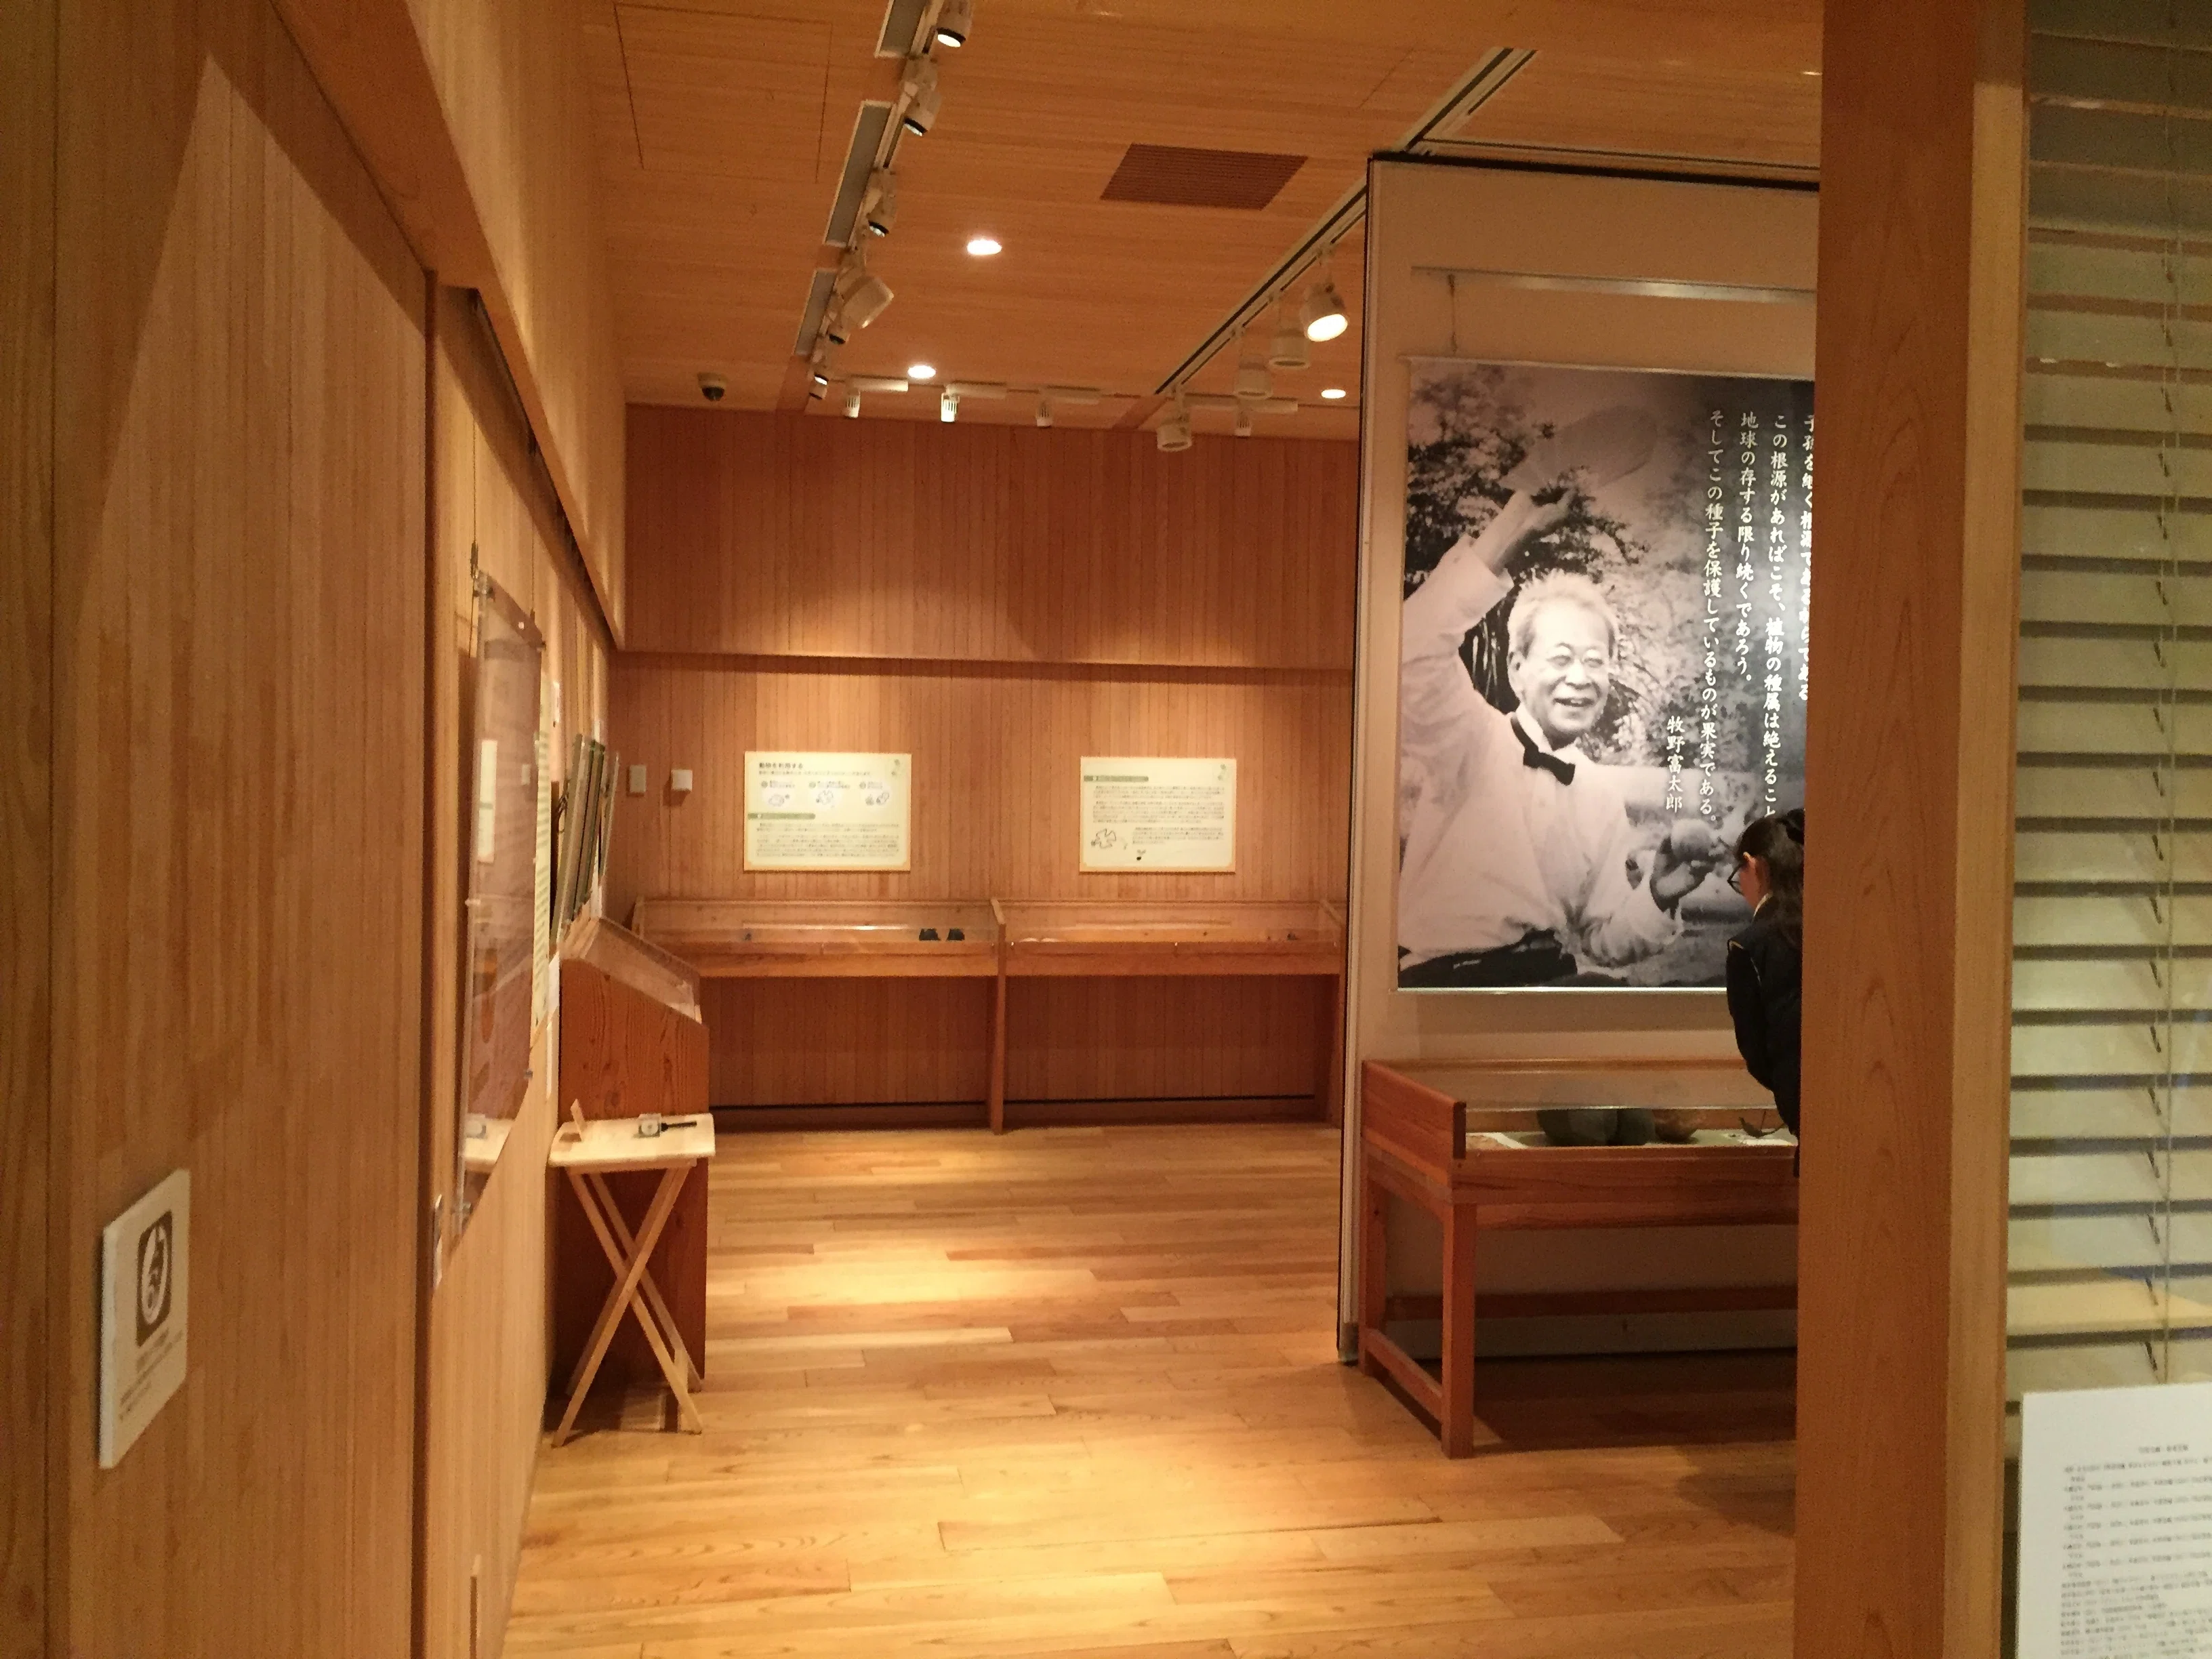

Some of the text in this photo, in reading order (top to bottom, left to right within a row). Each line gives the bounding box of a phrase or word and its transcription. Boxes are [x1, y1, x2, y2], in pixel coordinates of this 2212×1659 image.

[1699, 409, 1724, 821] そしてこの種子を保護しているものが果実である。
[1735, 410, 1759, 681] 地球の存する限り続くであろう。
[1666, 716, 1685, 814] 牧野富太郎
